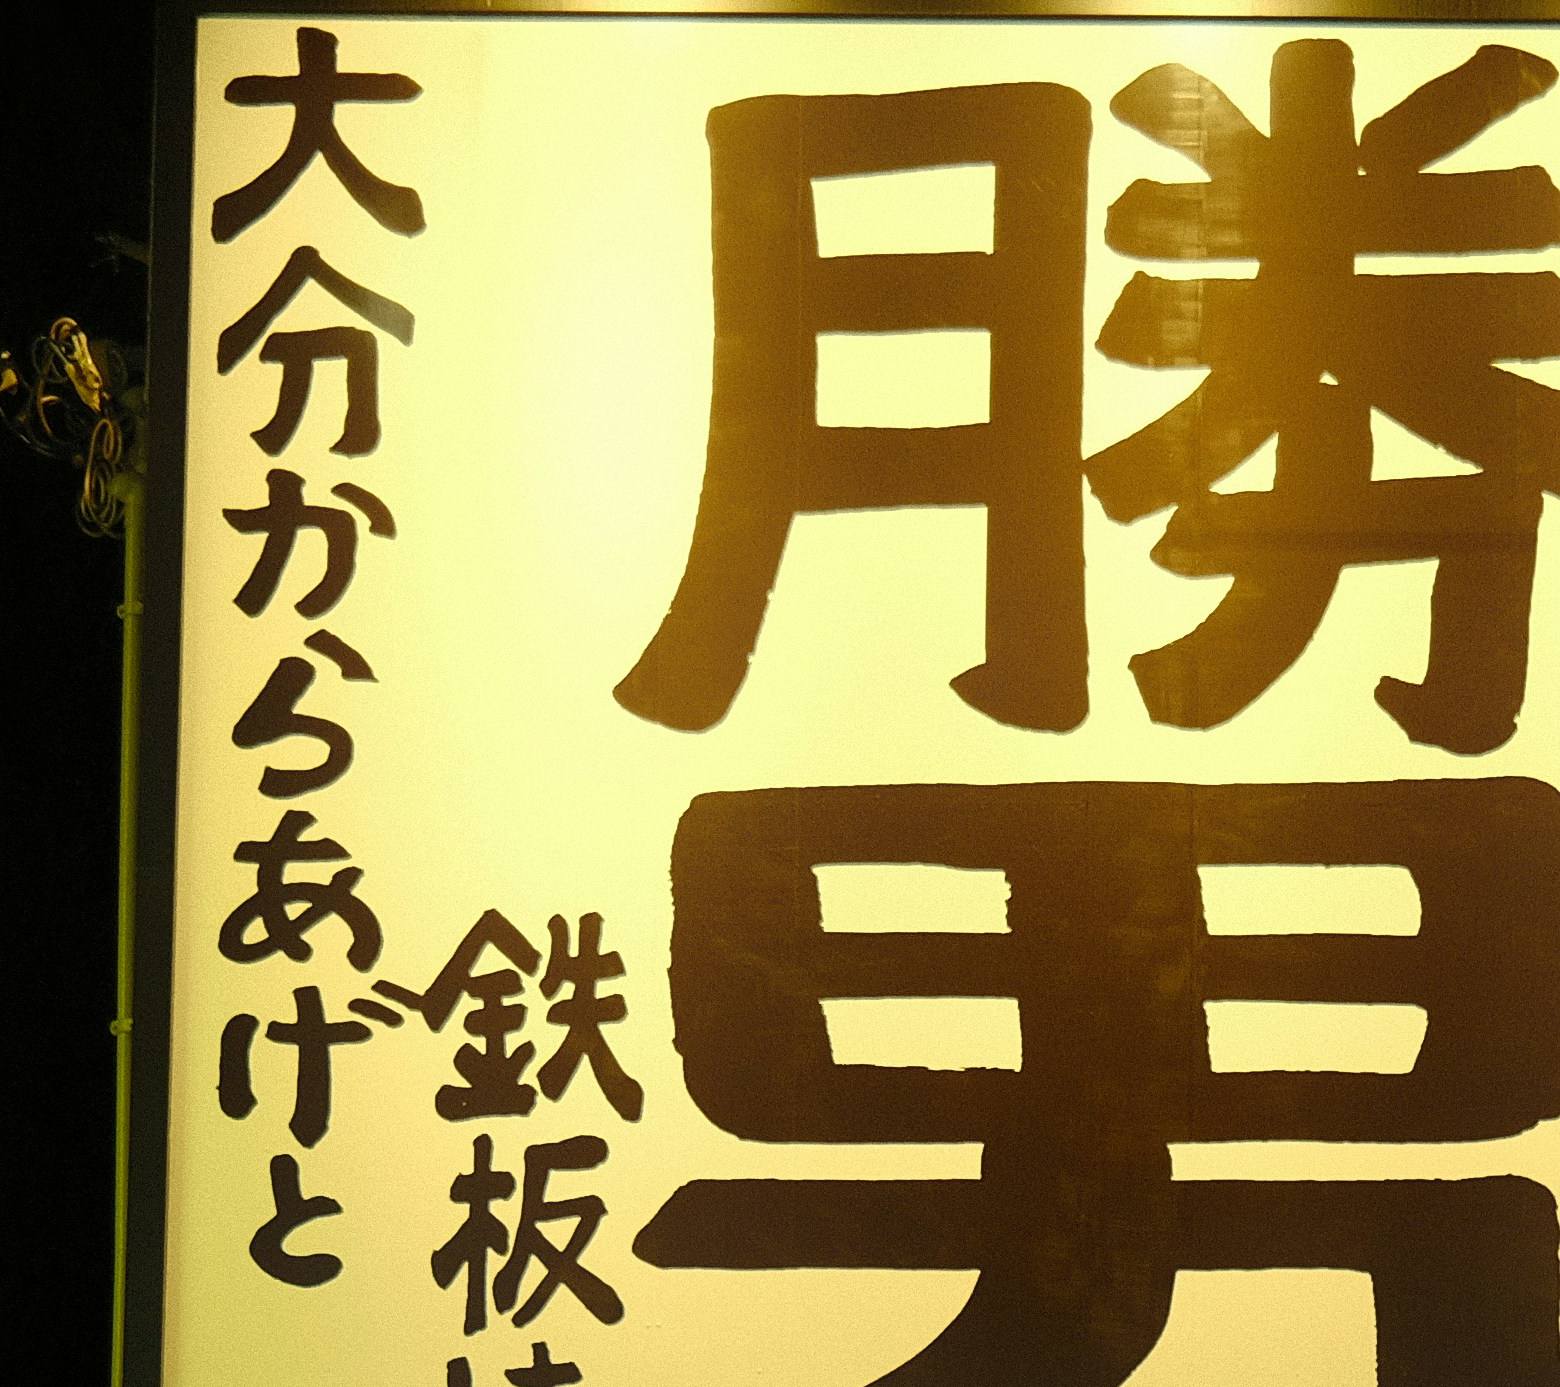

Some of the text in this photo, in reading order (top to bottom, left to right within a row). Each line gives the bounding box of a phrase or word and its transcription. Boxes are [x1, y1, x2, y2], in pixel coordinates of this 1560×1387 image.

[212, 28, 426, 1287] 大分からあげと
